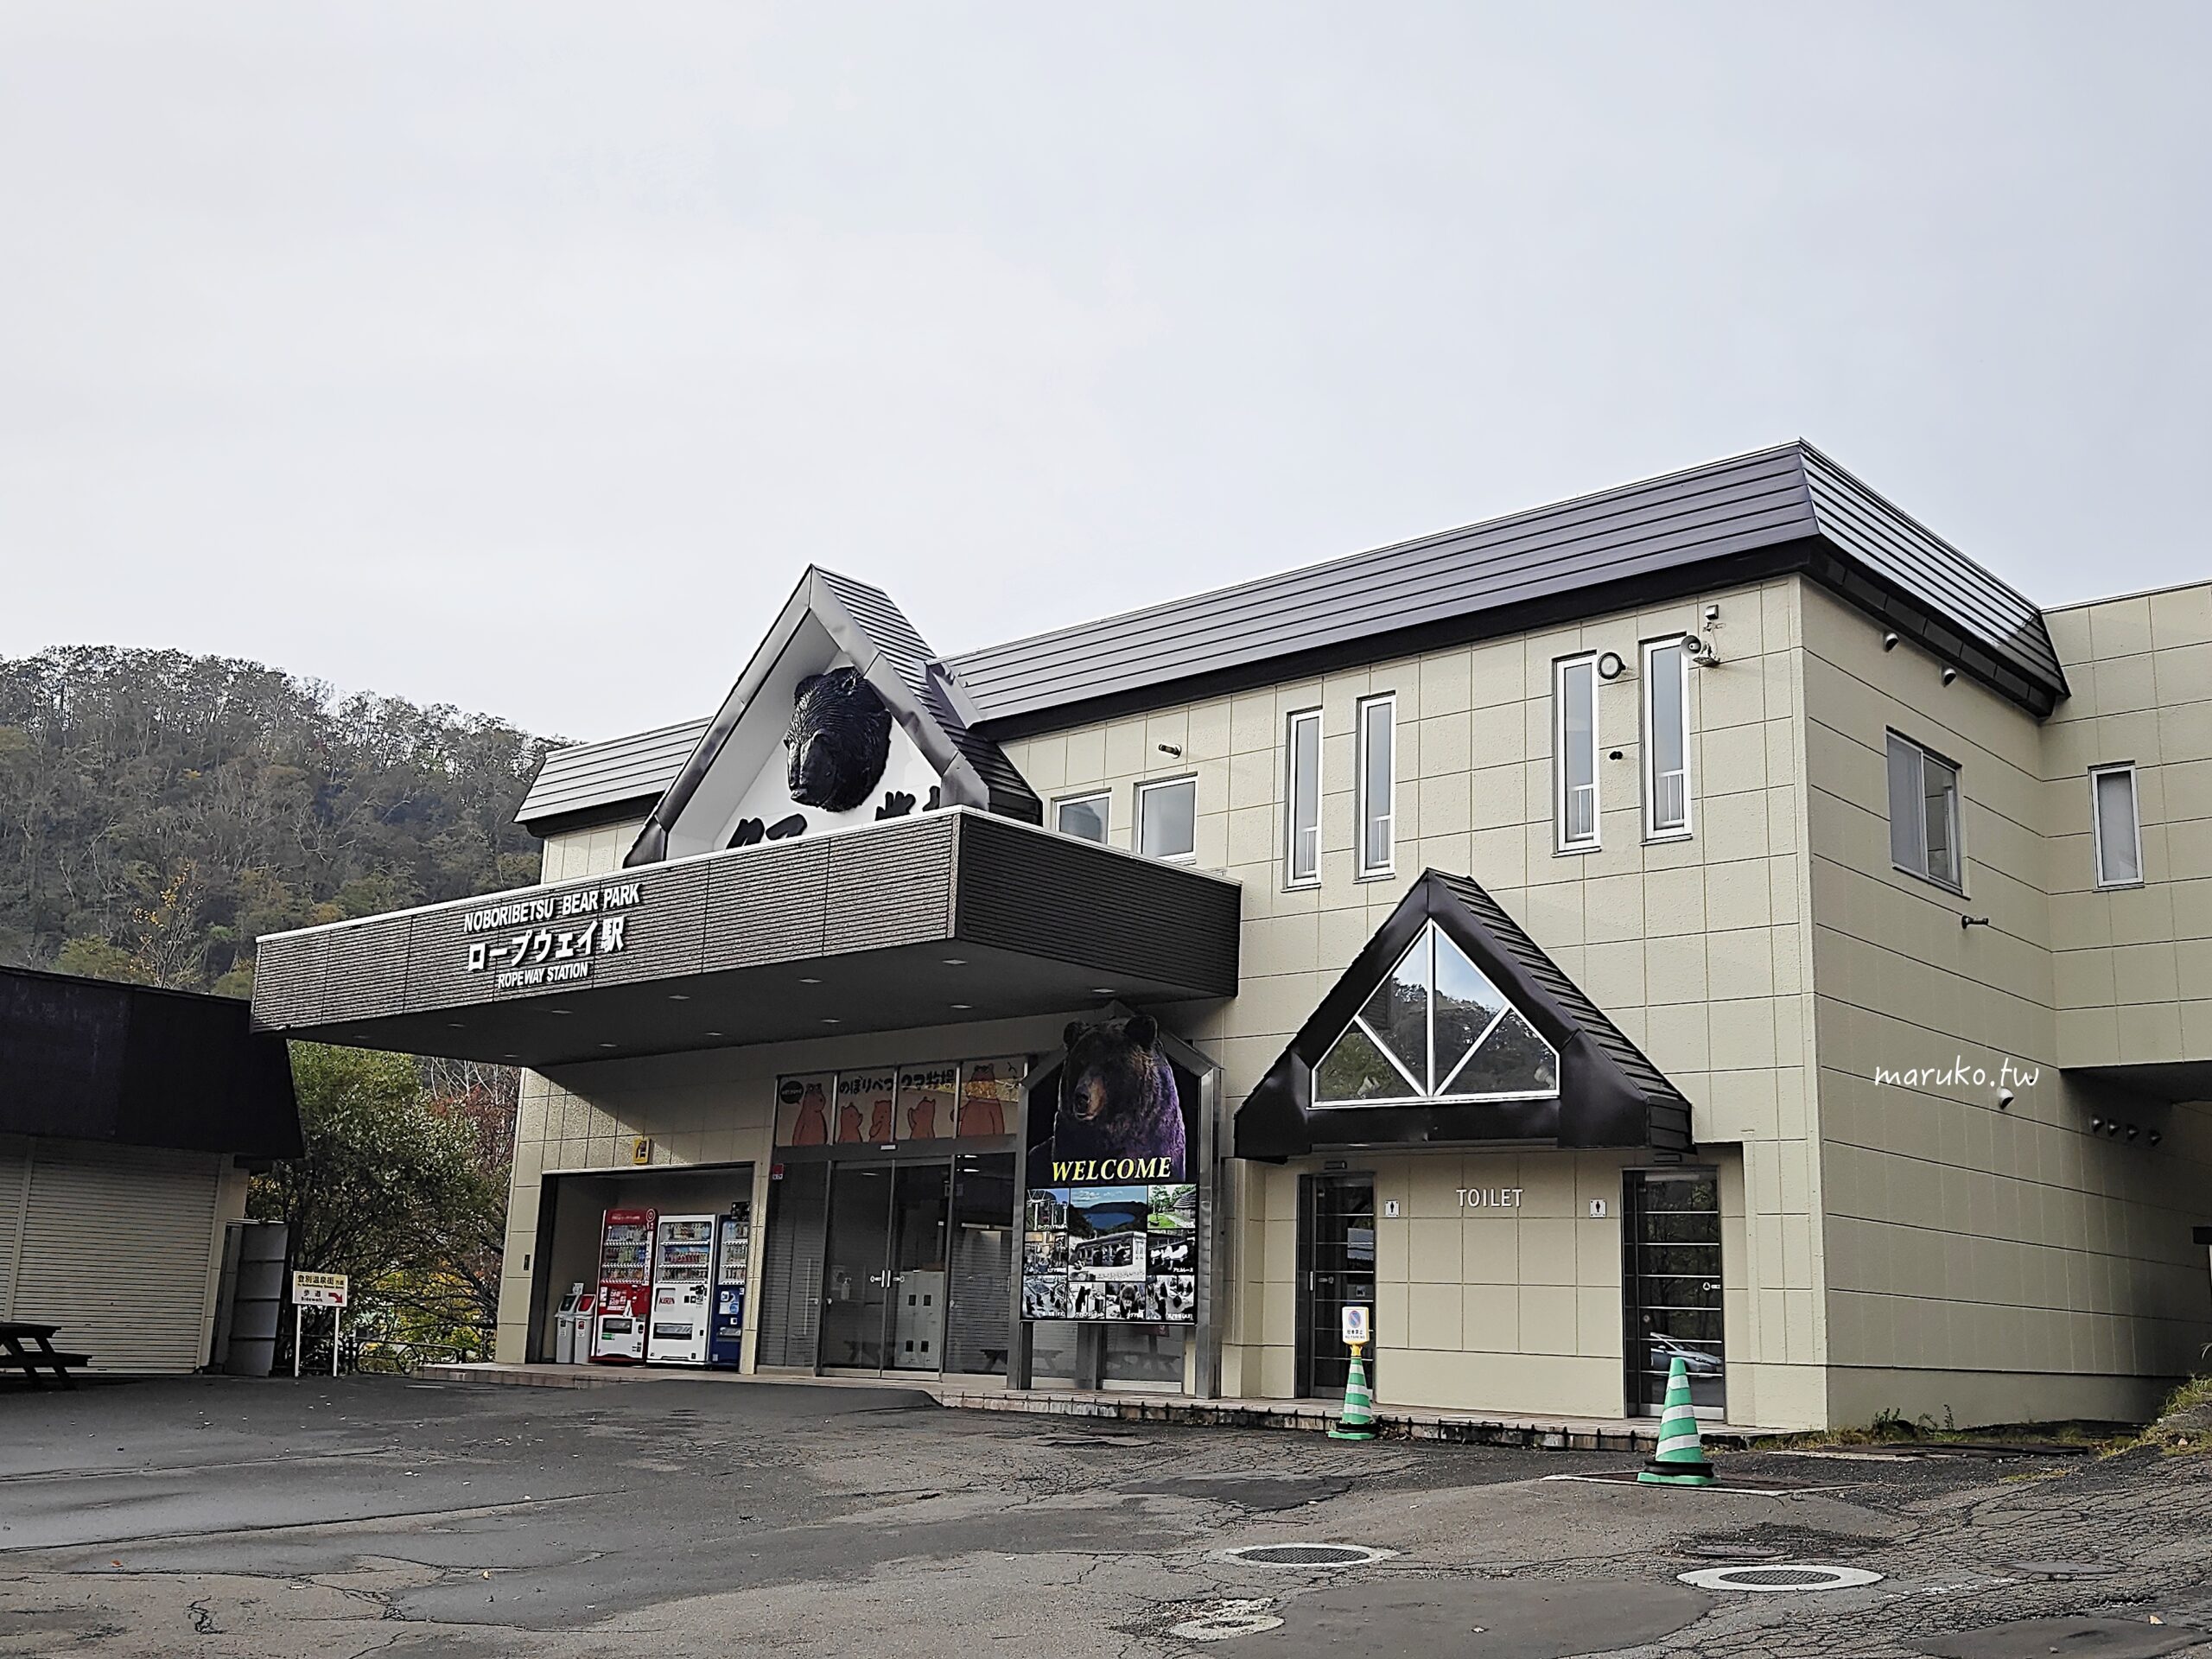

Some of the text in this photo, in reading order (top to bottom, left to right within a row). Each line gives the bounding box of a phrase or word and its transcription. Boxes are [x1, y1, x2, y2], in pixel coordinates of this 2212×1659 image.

[463, 883, 641, 932] NOBORIBETSU BEAR PARK
[467, 916, 626, 972] ロープウェイ駅
[498, 962, 588, 989] ROPEWAY STATION
[1052, 1157, 1173, 1182] WELCOME
[1456, 1188, 1524, 1208] TOILET
